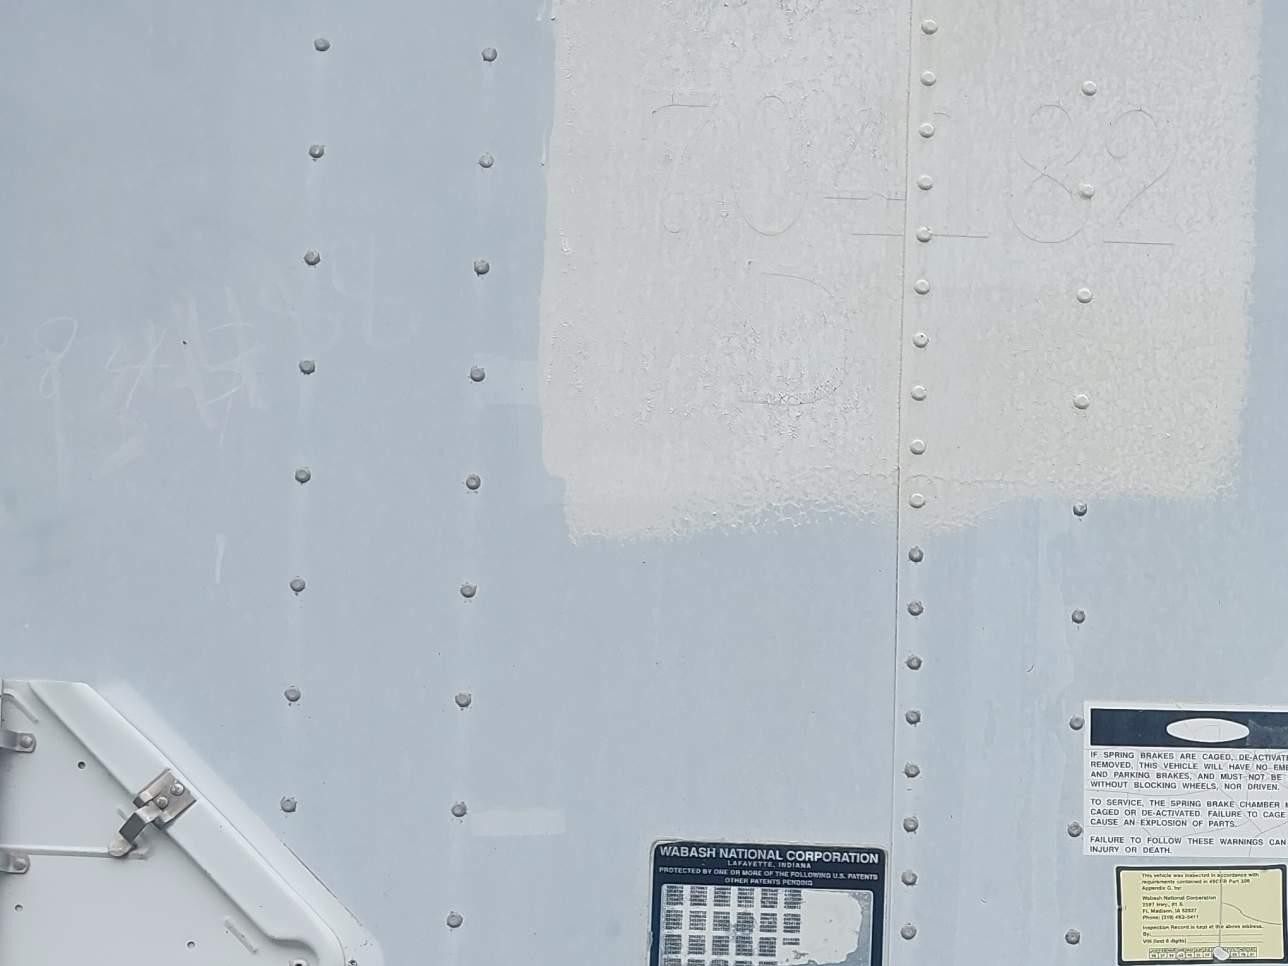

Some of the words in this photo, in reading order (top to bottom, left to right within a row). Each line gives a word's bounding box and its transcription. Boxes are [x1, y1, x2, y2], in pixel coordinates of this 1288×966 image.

[1103, 751, 1135, 759] SPRING
[1113, 771, 1150, 779] PARKING
[1134, 781, 1177, 789] BLOCKING
[1149, 799, 1166, 807] THE
[1206, 800, 1235, 808] BRAKE
[1090, 808, 1119, 816] CAGED
[1207, 810, 1242, 818] FAILURE
[1090, 818, 1119, 826] CAUSE
[1140, 819, 1187, 827] EXPLOSION
[1090, 836, 1125, 844] FAILURE
[1219, 838, 1264, 846] WARNINGS
[659, 846, 716, 858] WABASH
[720, 848, 783, 860] NATIONAL
[786, 850, 879, 864] CORPORATION
[778, 861, 811, 869] INDIANA
[790, 871, 831, 879] FOLLOWING
